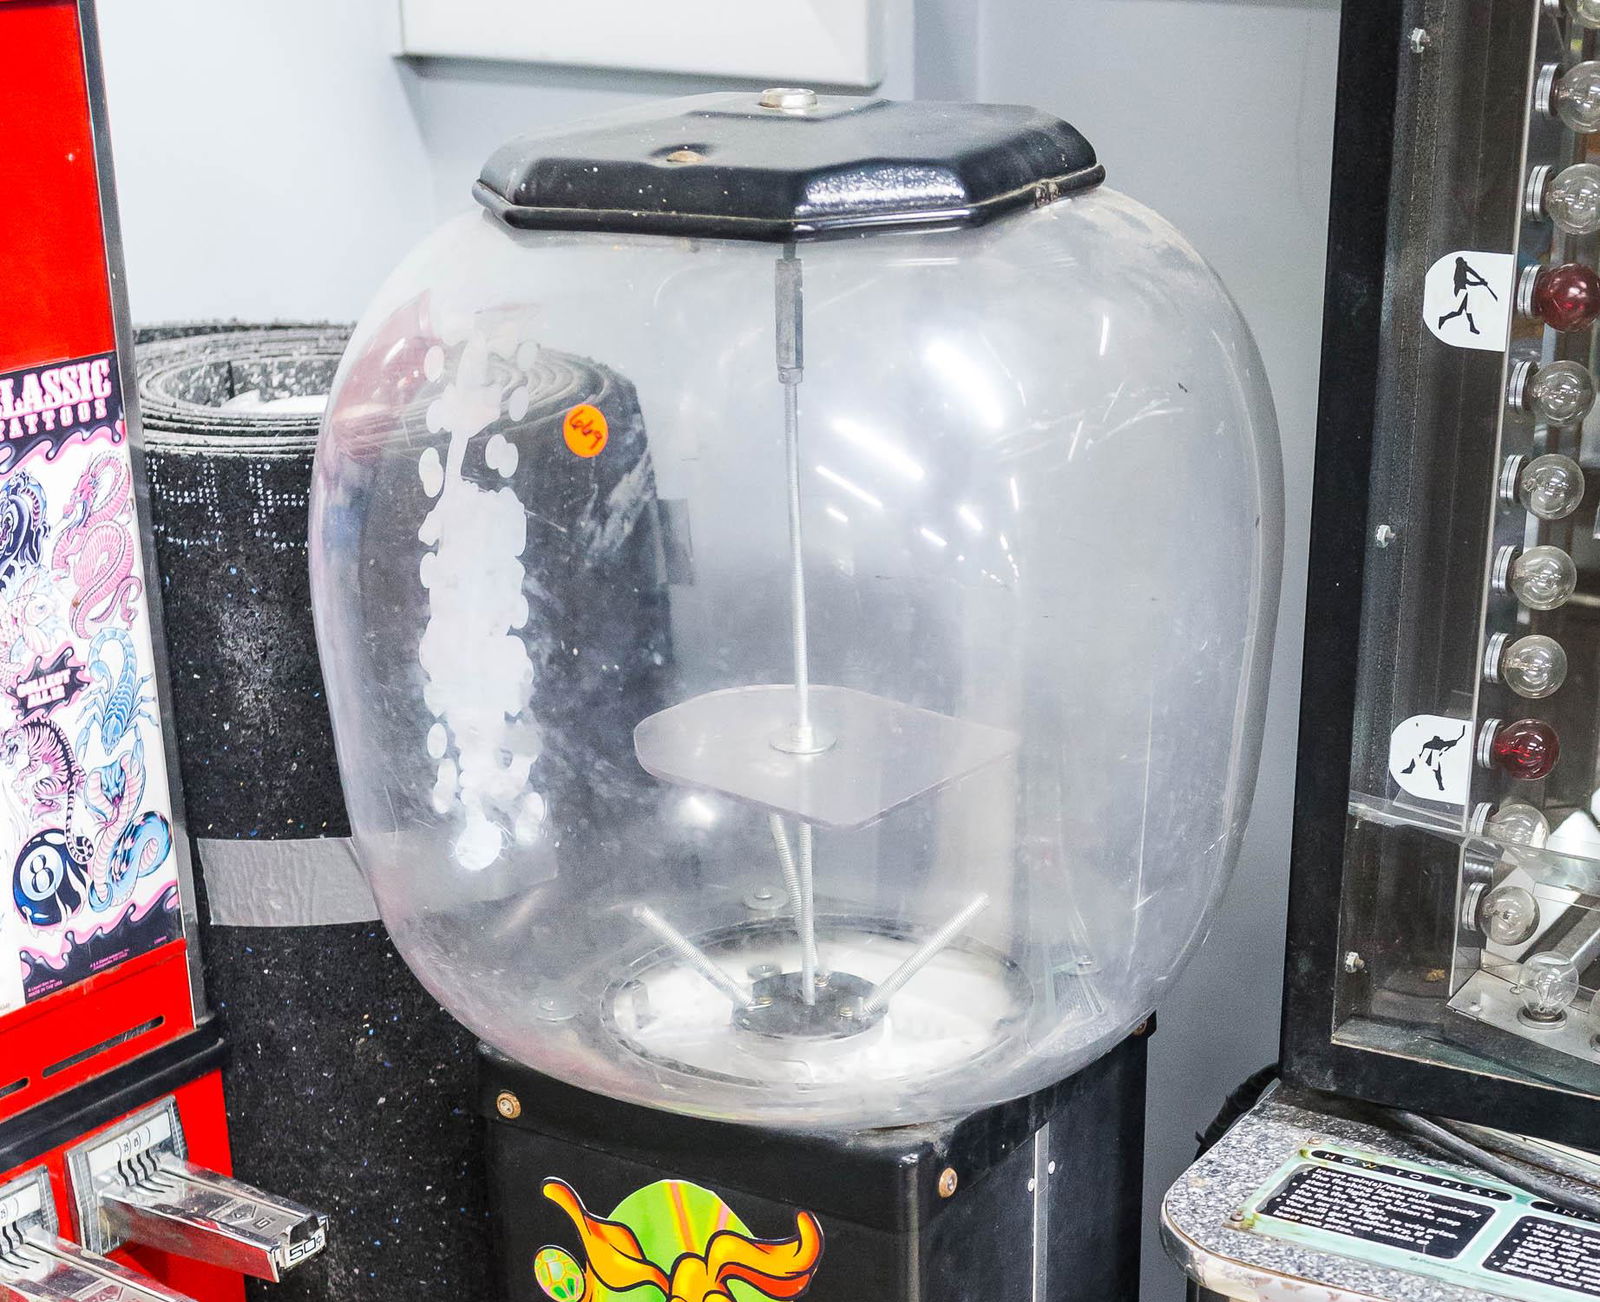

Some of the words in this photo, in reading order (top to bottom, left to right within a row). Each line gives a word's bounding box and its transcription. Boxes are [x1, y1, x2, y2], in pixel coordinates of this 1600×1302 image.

[0, 358, 112, 420] LASSIC
[30, 854, 54, 893] 8
[1325, 1154, 1377, 1169] HOW
[1396, 1170, 1422, 1180] TO
[1441, 1181, 1497, 1197] PLAY
[1532, 1229, 1553, 1239] You
[1555, 1236, 1581, 1246] may
[1536, 1223, 1558, 1234] This
[289, 1234, 323, 1262] 50¢
